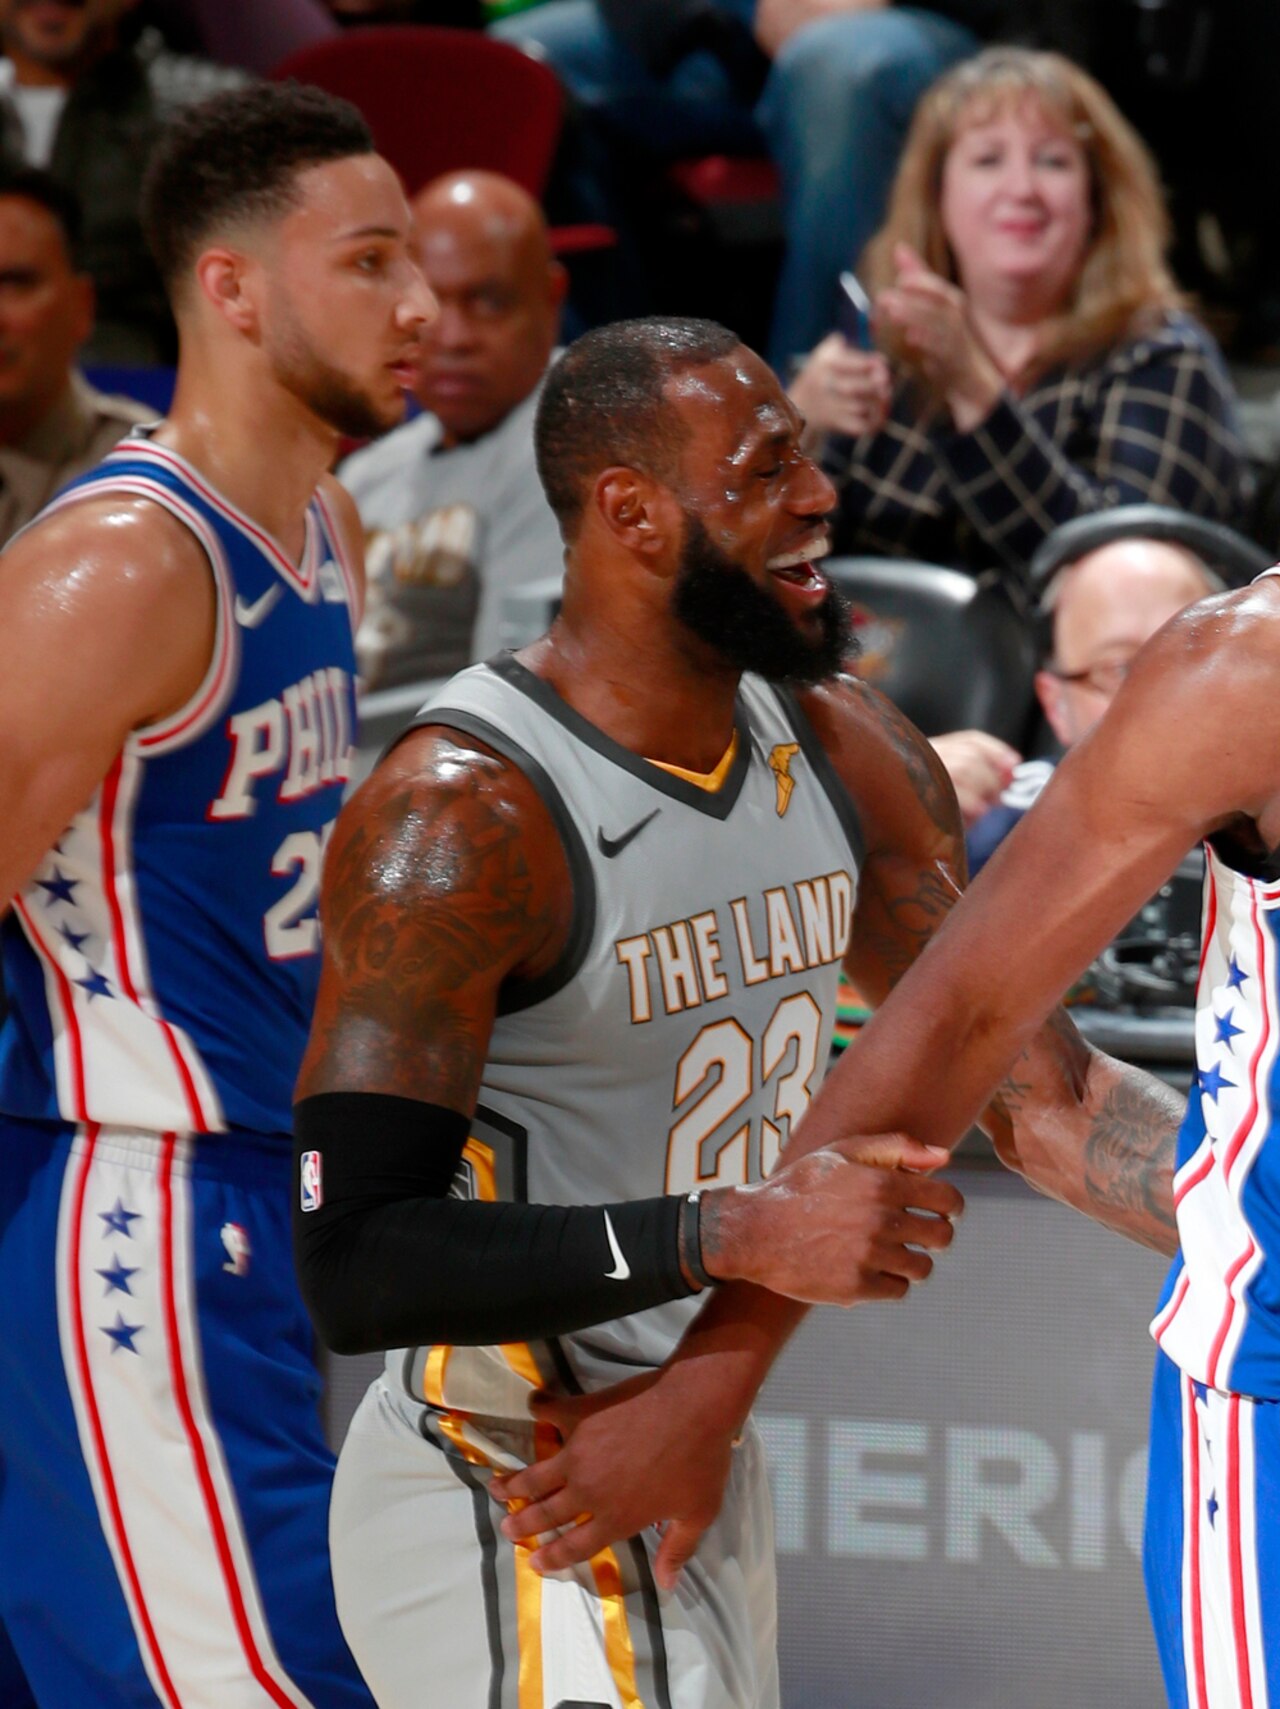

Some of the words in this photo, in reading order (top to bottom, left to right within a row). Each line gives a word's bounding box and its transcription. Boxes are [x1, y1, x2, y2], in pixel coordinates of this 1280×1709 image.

[263, 818, 336, 961] 2
[615, 909, 730, 1025] THE
[728, 869, 853, 987] LAND
[664, 989, 823, 1197] 23
